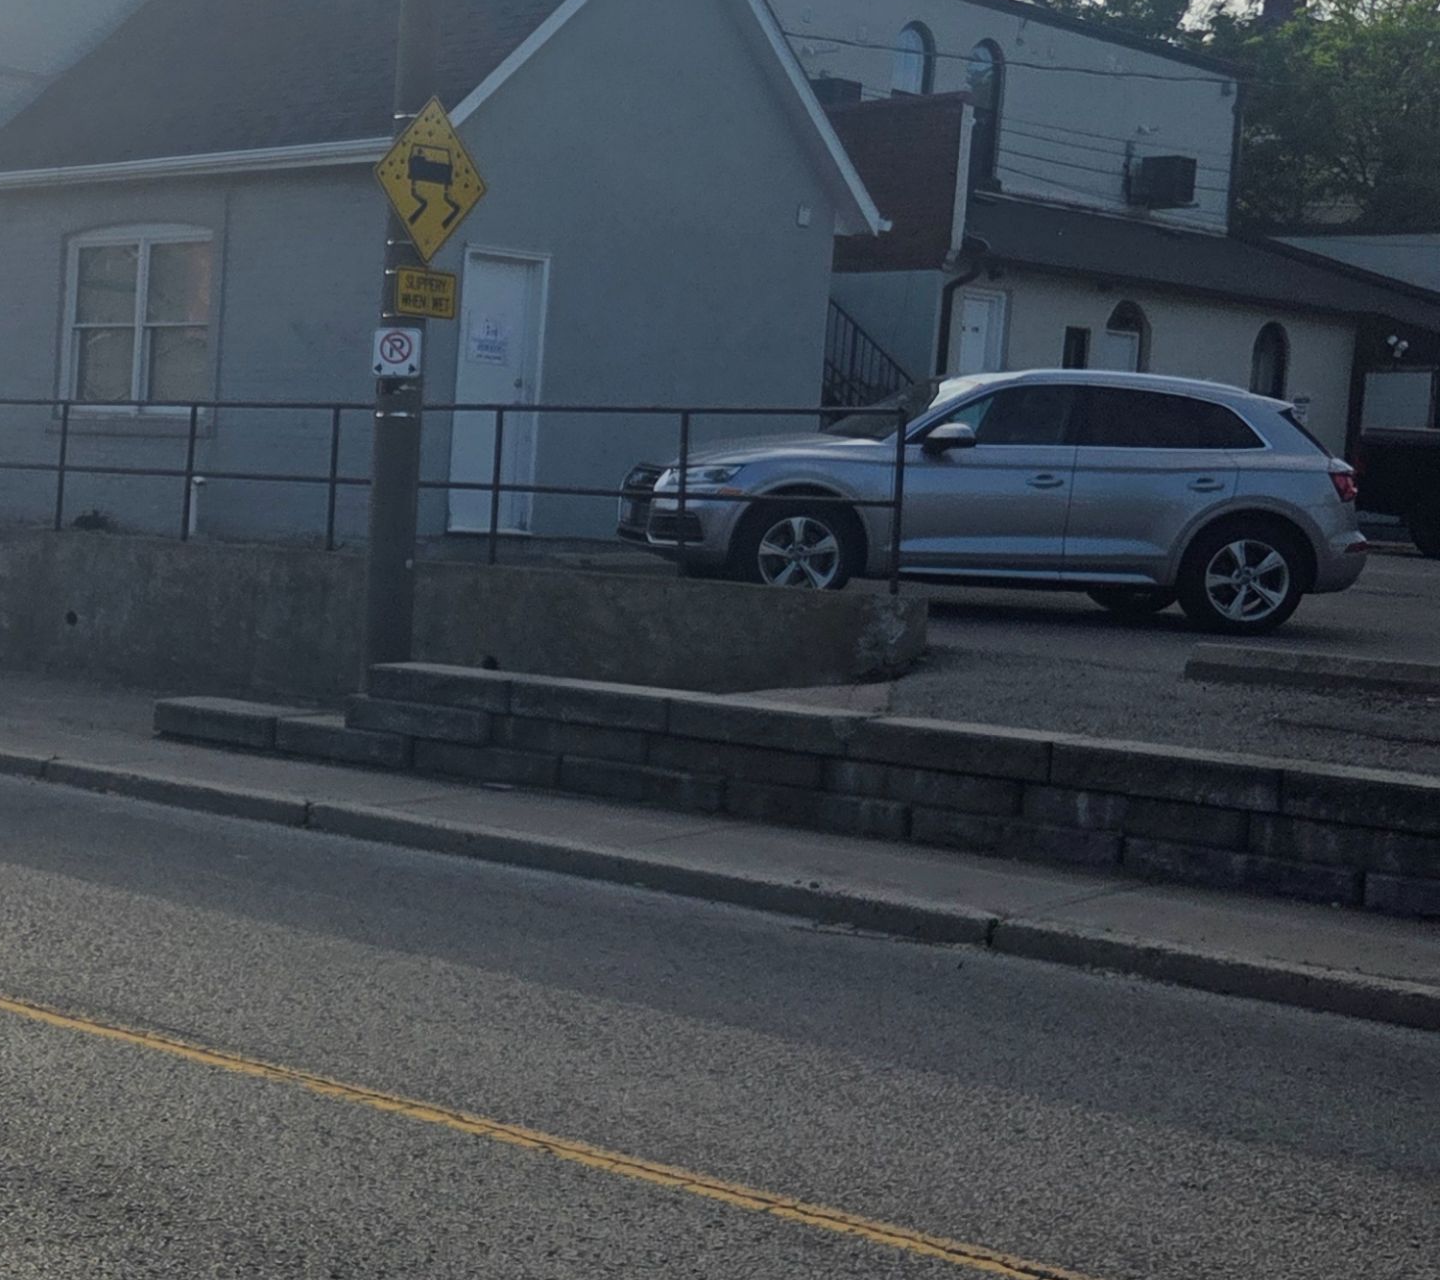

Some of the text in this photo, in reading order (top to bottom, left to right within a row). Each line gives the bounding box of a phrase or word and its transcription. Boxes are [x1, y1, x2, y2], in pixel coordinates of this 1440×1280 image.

[405, 274, 448, 293] SLIPPERY
[401, 293, 450, 313] WHEN WET
